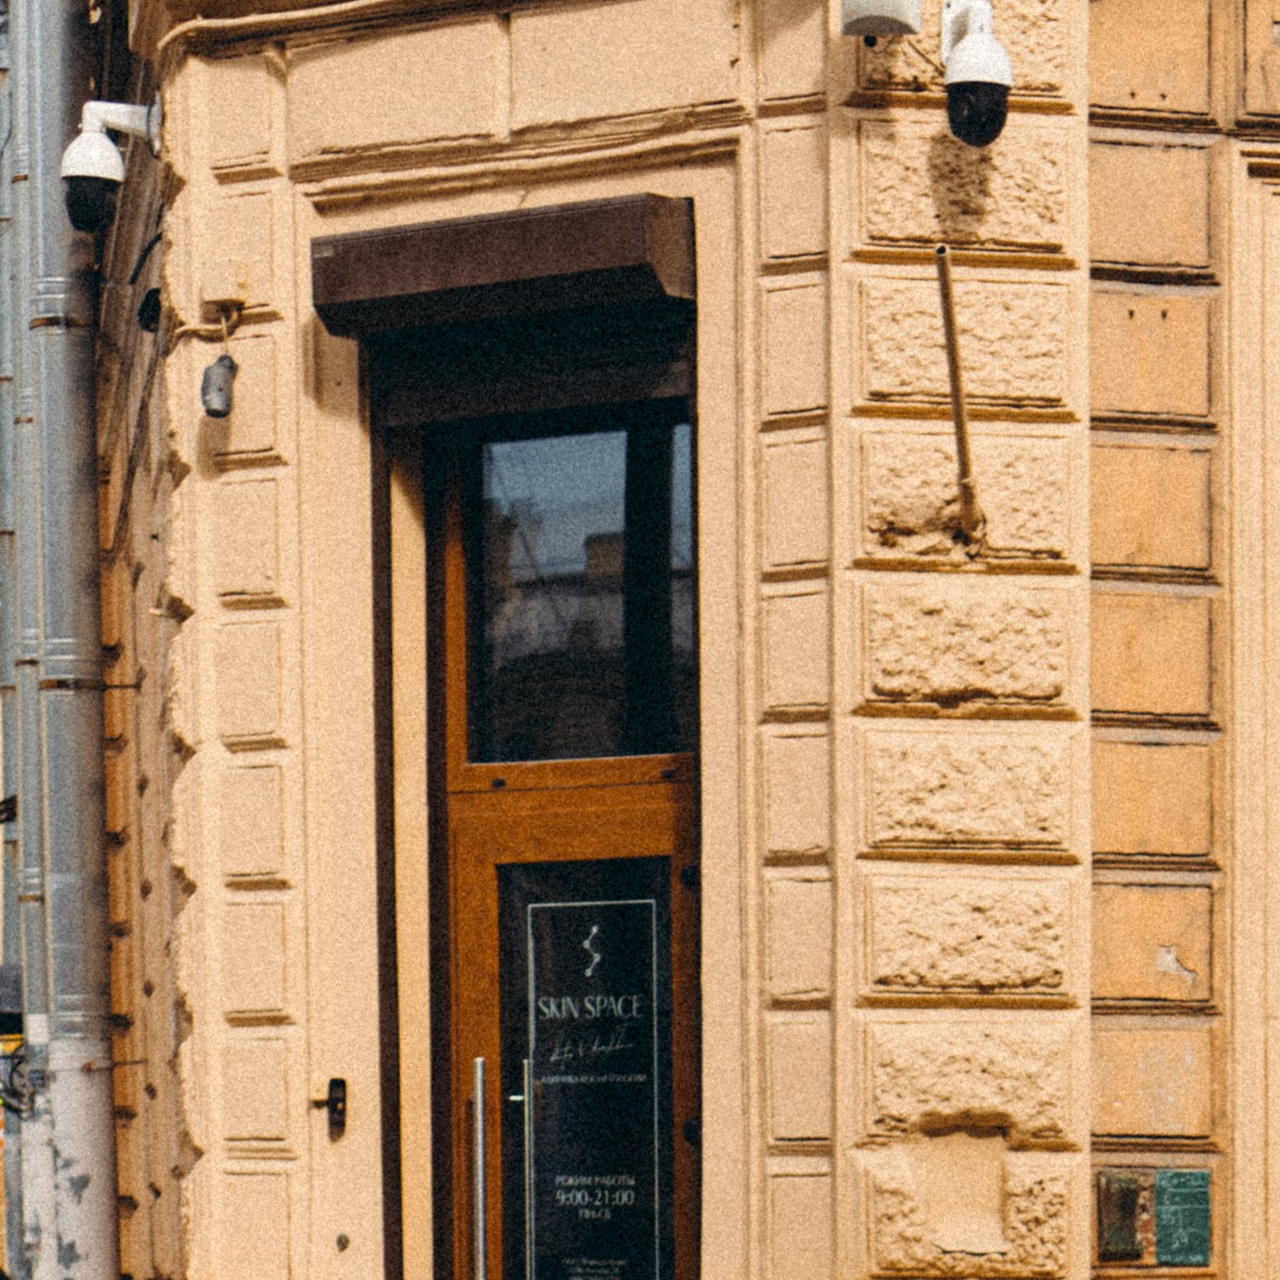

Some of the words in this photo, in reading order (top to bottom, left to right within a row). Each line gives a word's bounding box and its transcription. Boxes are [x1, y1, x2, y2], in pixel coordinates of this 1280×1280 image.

[538, 995, 579, 1019] SKIN
[584, 994, 644, 1018] SPACE
[556, 1189, 635, 1206] 9:00-21:00
